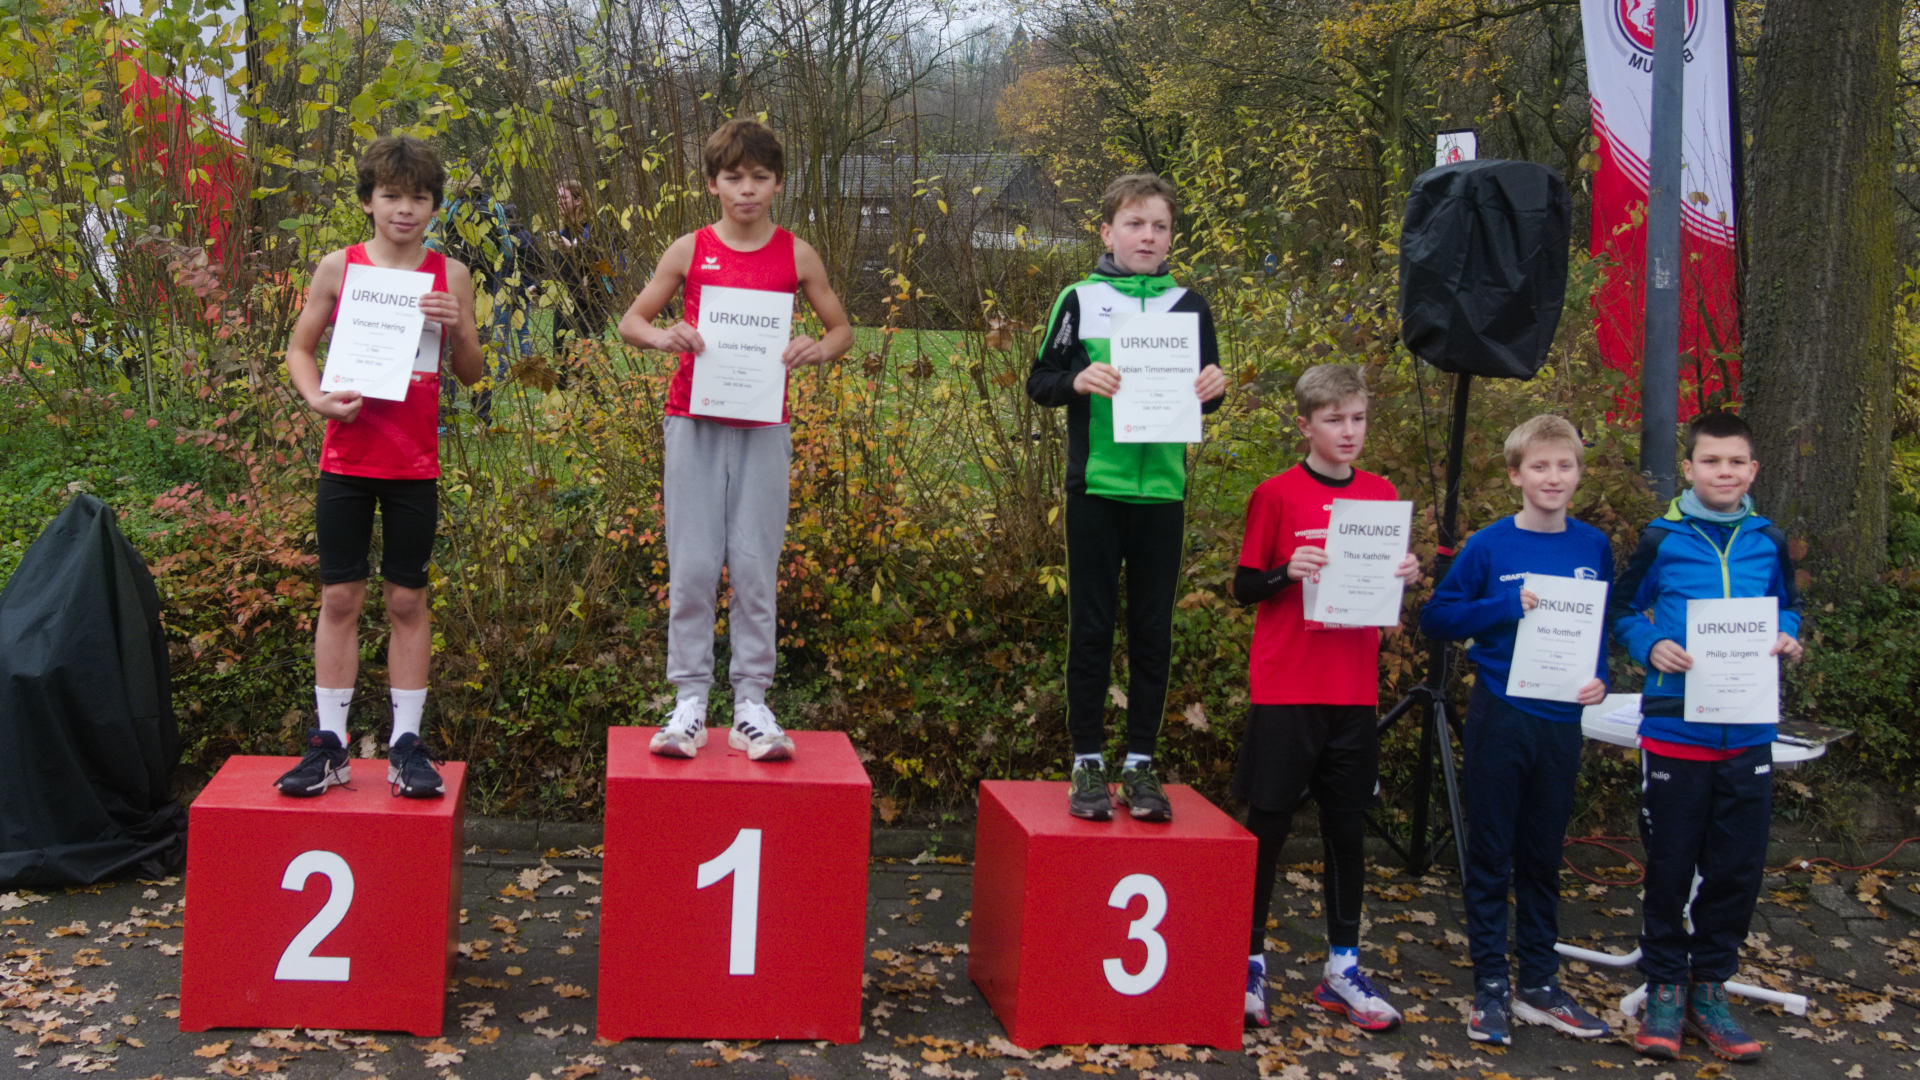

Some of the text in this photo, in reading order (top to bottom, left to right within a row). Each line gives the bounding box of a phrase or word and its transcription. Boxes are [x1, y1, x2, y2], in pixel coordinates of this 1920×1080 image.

[351, 289, 418, 309] URKUNDE
[352, 318, 406, 333] Vincent Hering
[709, 311, 781, 329] URKUNDE
[718, 341, 767, 354] Louis Hering
[1120, 337, 1189, 349] URKUNDE
[1118, 365, 1193, 374] Fabian Timmermann
[1338, 523, 1401, 537] URKUNDE
[1536, 626, 1551, 634] Mio
[1697, 621, 1767, 635] URKUNDE
[1705, 649, 1759, 660] Philip Jürgens
[696, 828, 762, 976] 1
[273, 849, 355, 982] 2
[1102, 873, 1168, 996] 3
